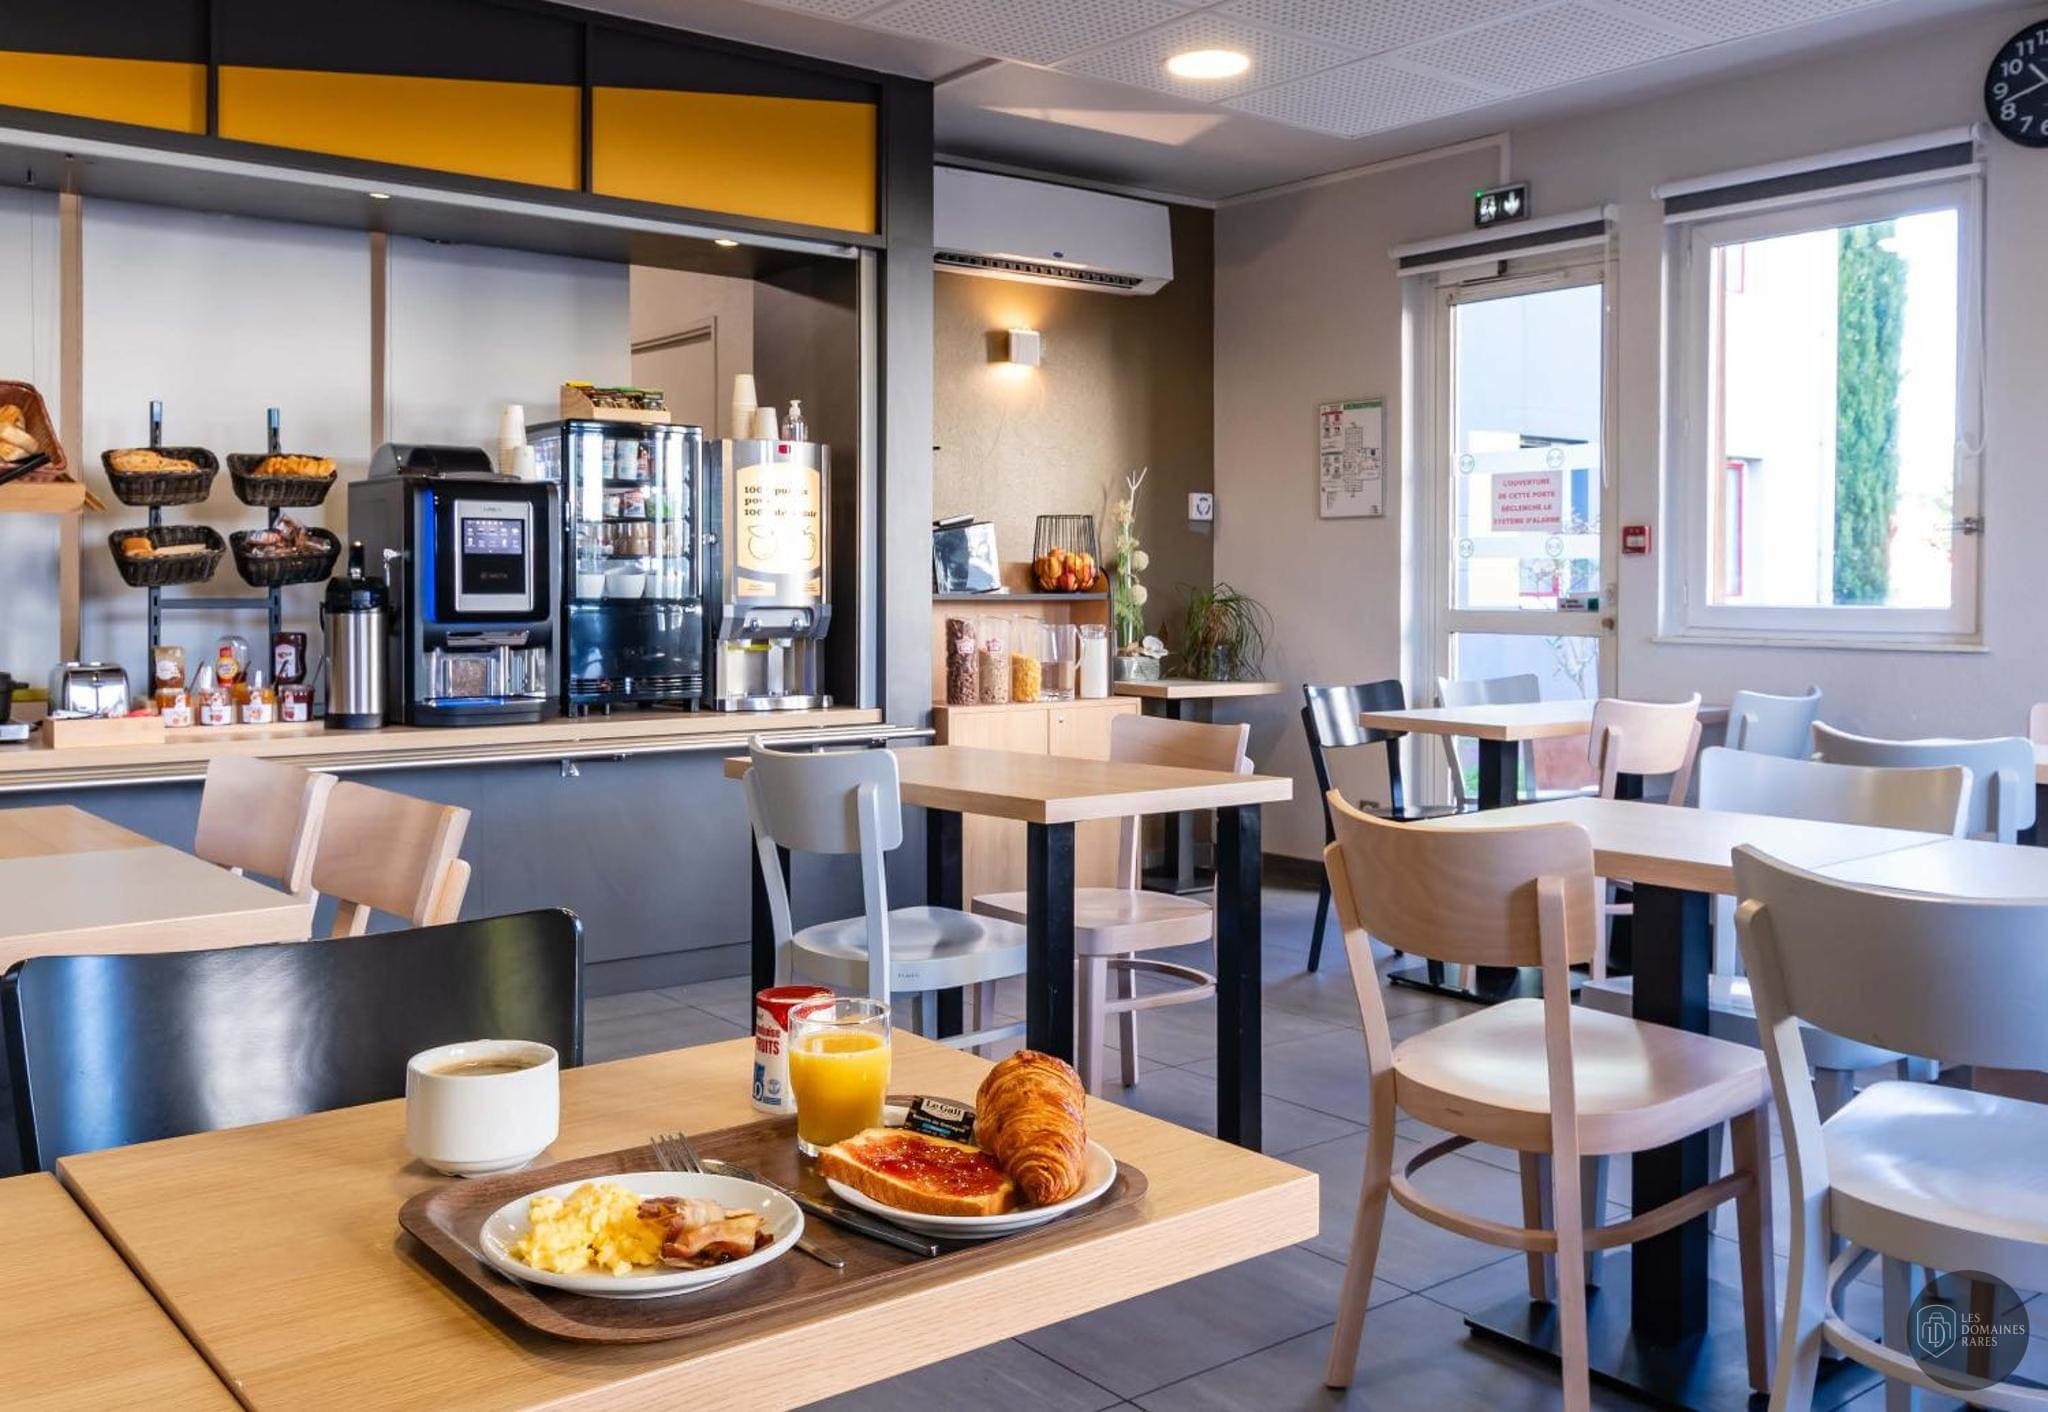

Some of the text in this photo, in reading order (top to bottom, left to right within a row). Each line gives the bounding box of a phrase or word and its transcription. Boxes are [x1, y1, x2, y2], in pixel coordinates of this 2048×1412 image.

[2016, 40, 2034, 56] 11
[2001, 58, 2022, 77] 10
[1993, 82, 2008, 100] 9
[2000, 102, 2016, 120] 8
[2020, 115, 2033, 133] 7
[1508, 492, 1530, 500] CETTE
